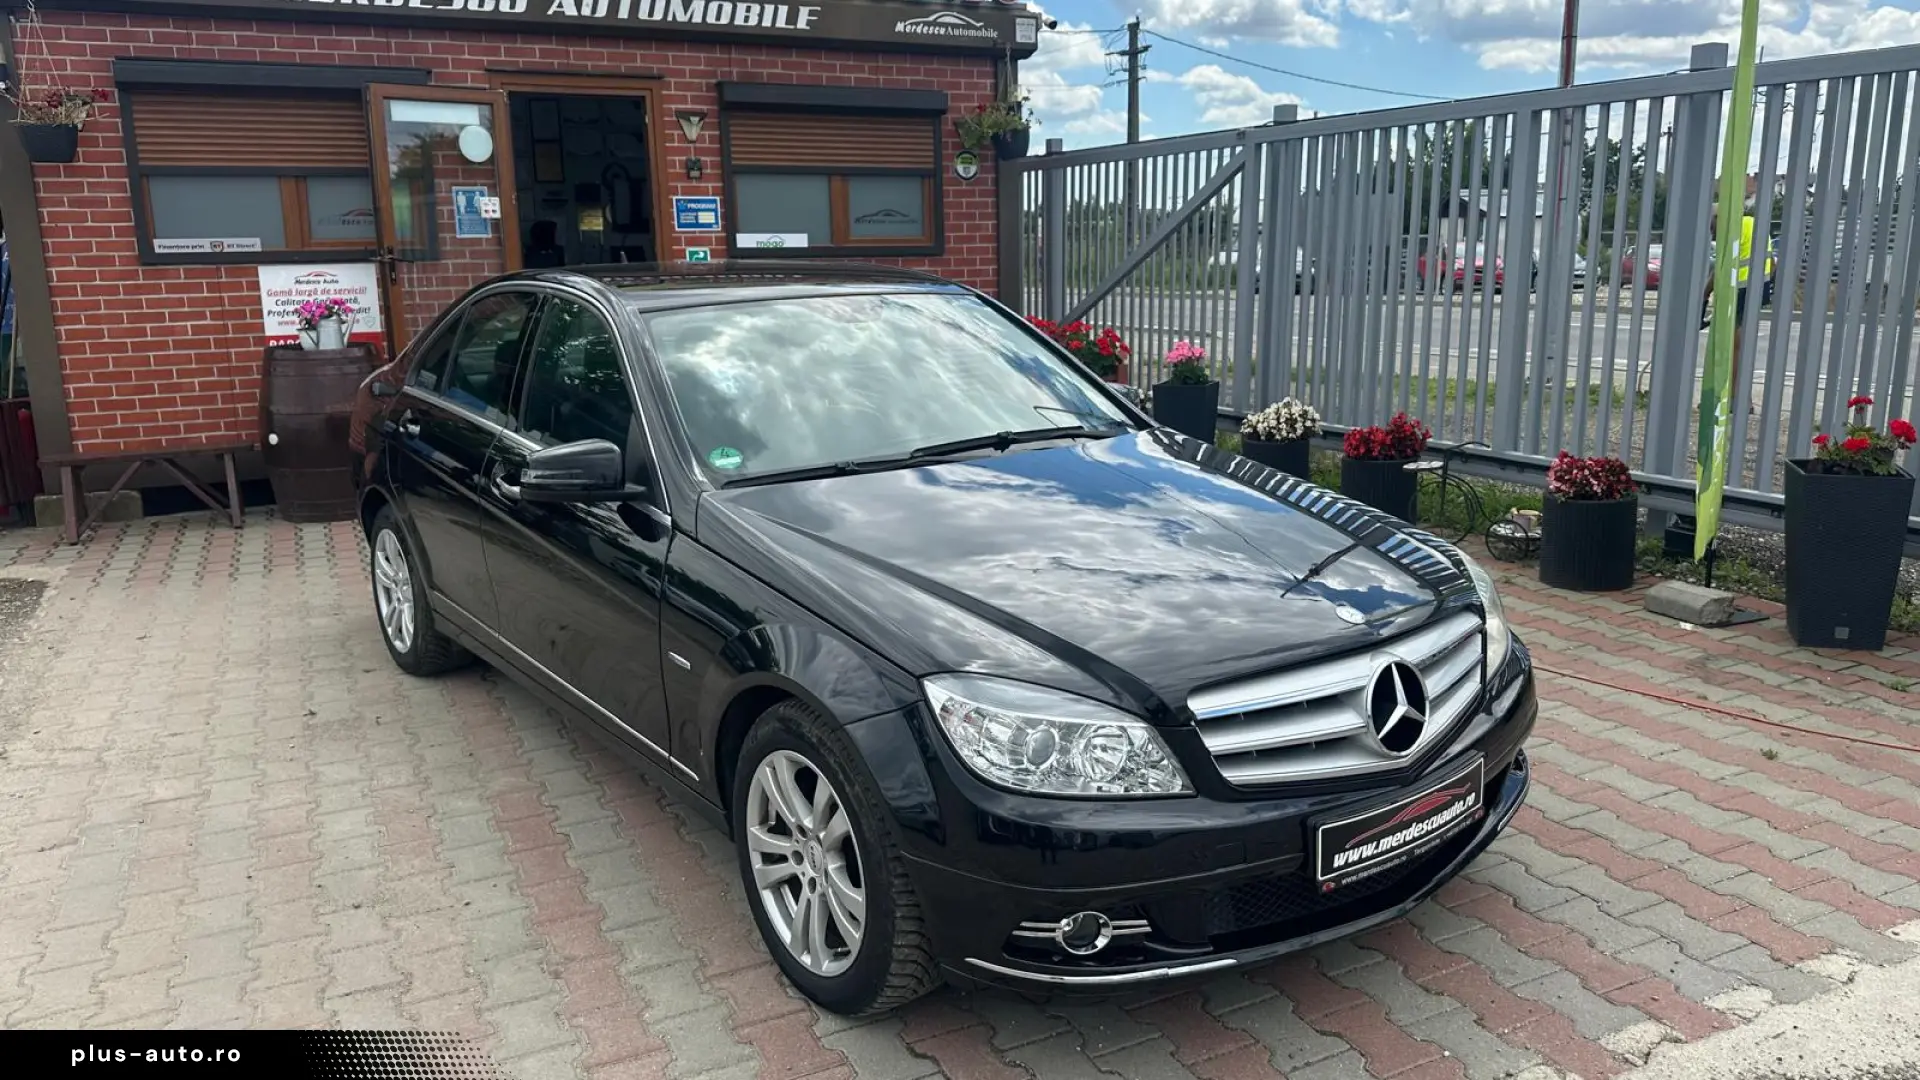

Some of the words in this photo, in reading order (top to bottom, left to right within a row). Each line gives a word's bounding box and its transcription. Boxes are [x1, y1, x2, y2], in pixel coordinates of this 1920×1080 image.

[547, 0, 821, 30] AUTOMOBILE
[320, 287, 332, 296] de
[1333, 792, 1476, 868] www.merdescuauto.ro
